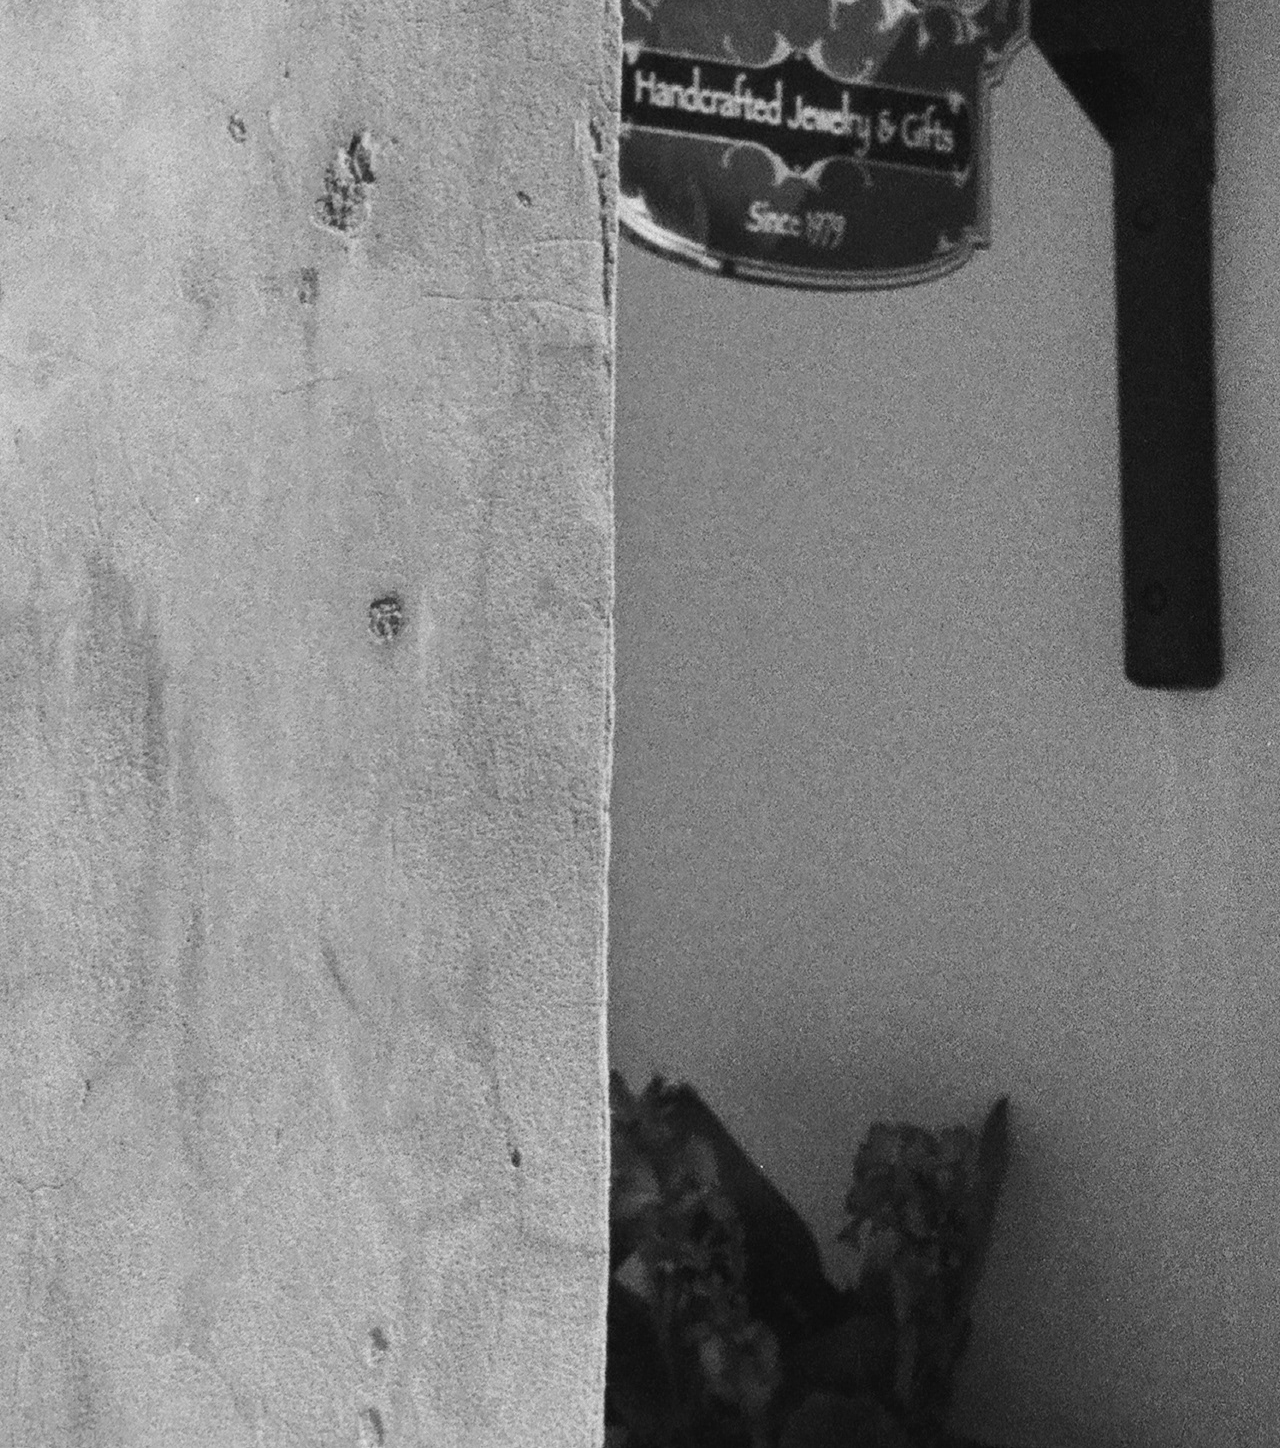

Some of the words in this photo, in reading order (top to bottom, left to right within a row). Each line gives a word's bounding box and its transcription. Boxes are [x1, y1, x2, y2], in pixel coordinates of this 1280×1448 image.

[634, 67, 783, 125] Handcrafted
[787, 92, 870, 156] Jewelry
[876, 111, 898, 143] &
[901, 104, 955, 154] Gifts
[745, 200, 801, 237] Since
